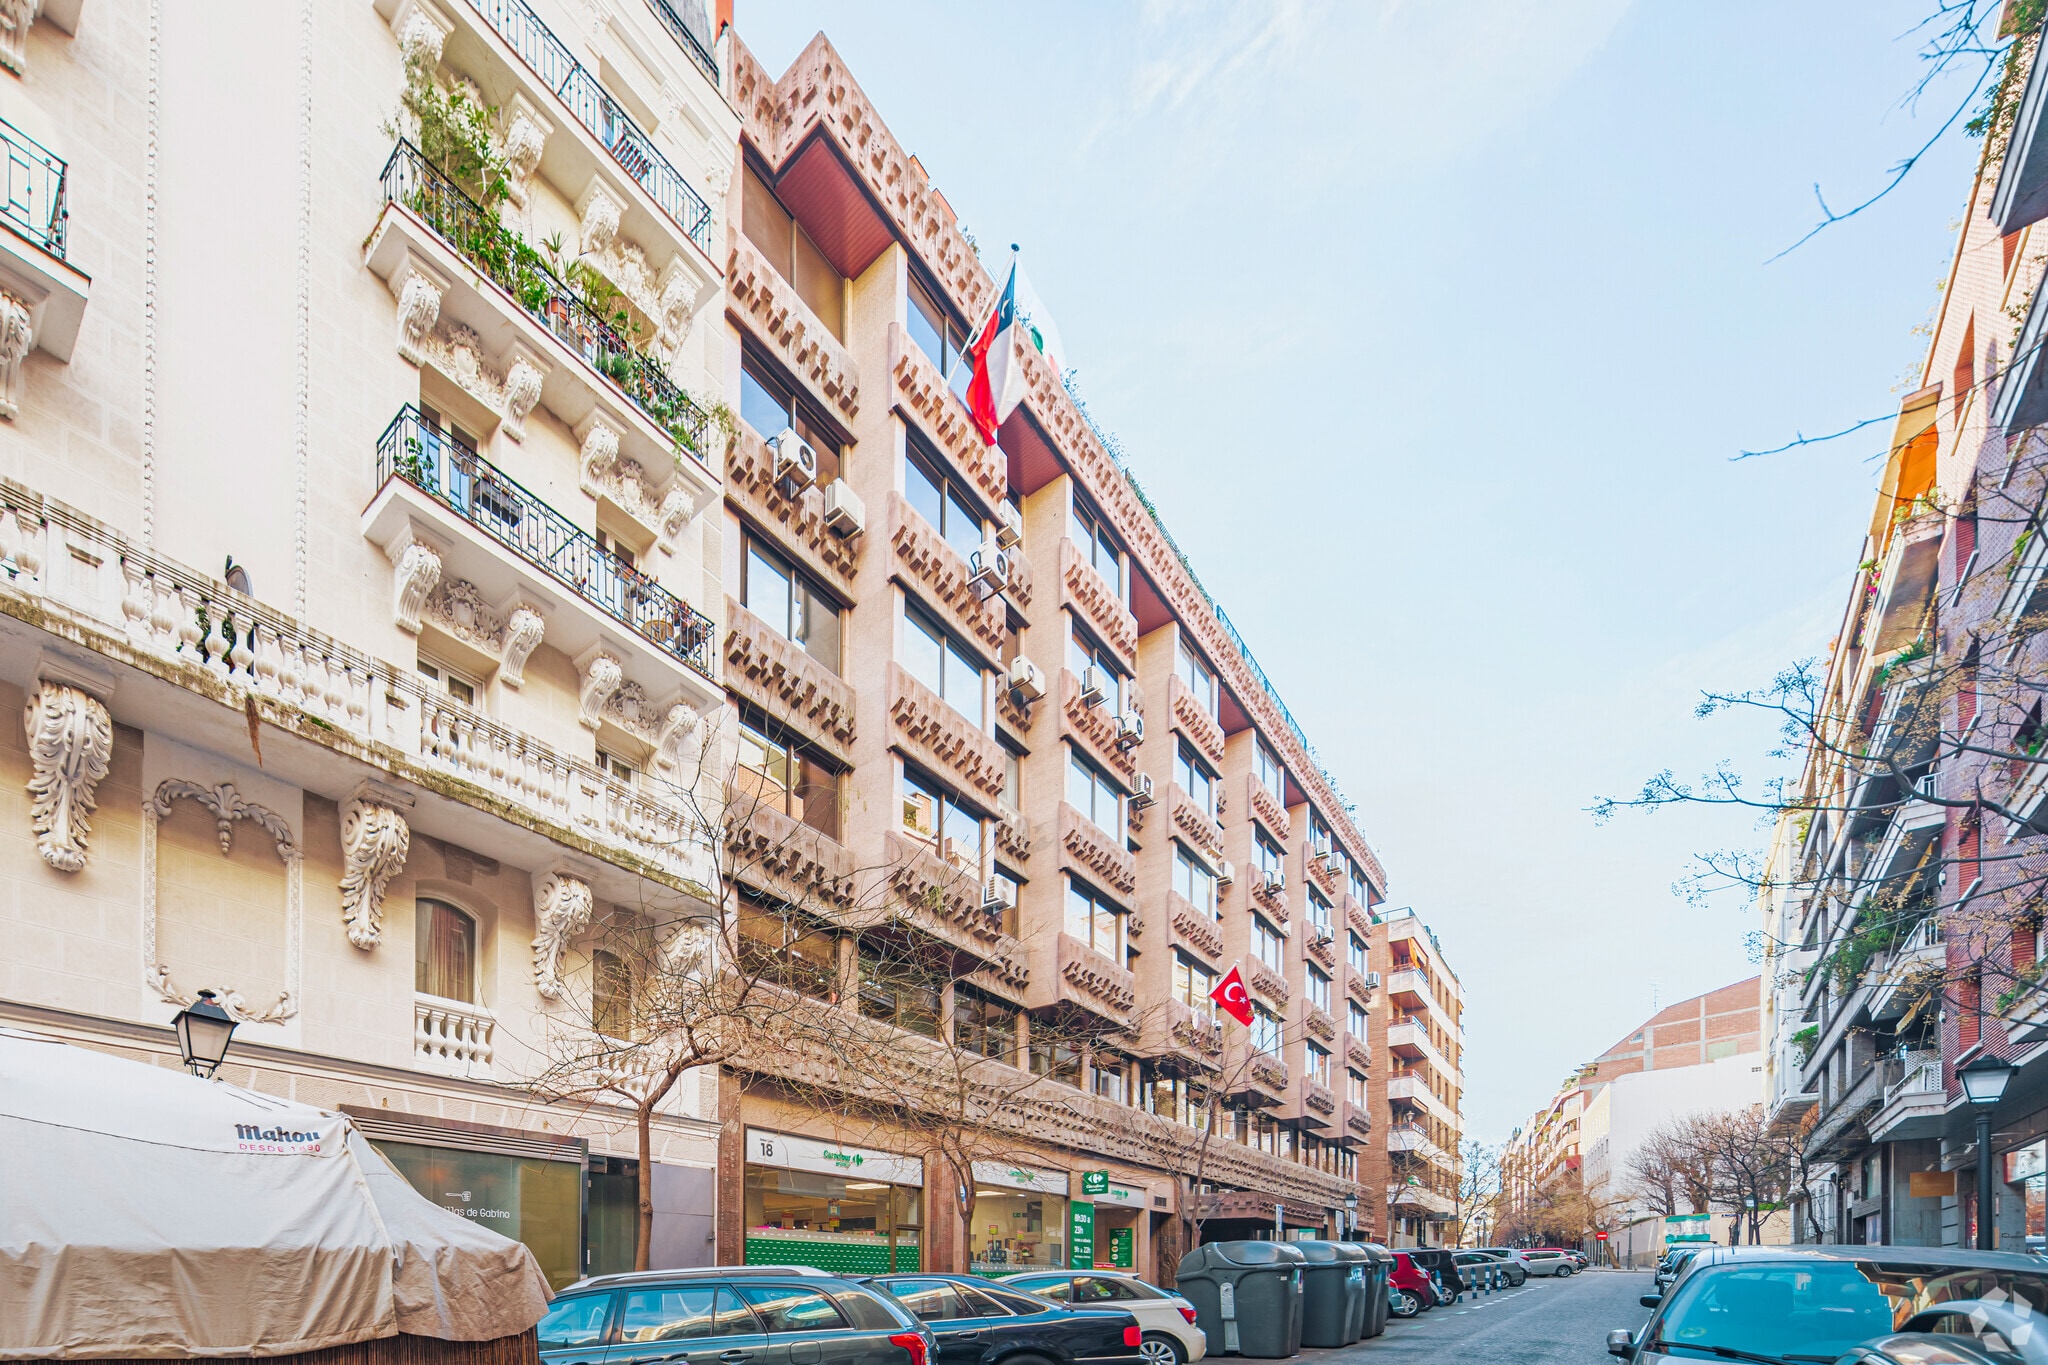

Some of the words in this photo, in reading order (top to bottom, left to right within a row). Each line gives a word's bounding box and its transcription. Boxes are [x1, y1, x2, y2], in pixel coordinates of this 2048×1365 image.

[235, 1124, 320, 1142] Mahou
[239, 1143, 284, 1152] DESDE
[760, 1143, 774, 1157] 18
[466, 1208, 478, 1217] de
[479, 1208, 510, 1219] Gabino
